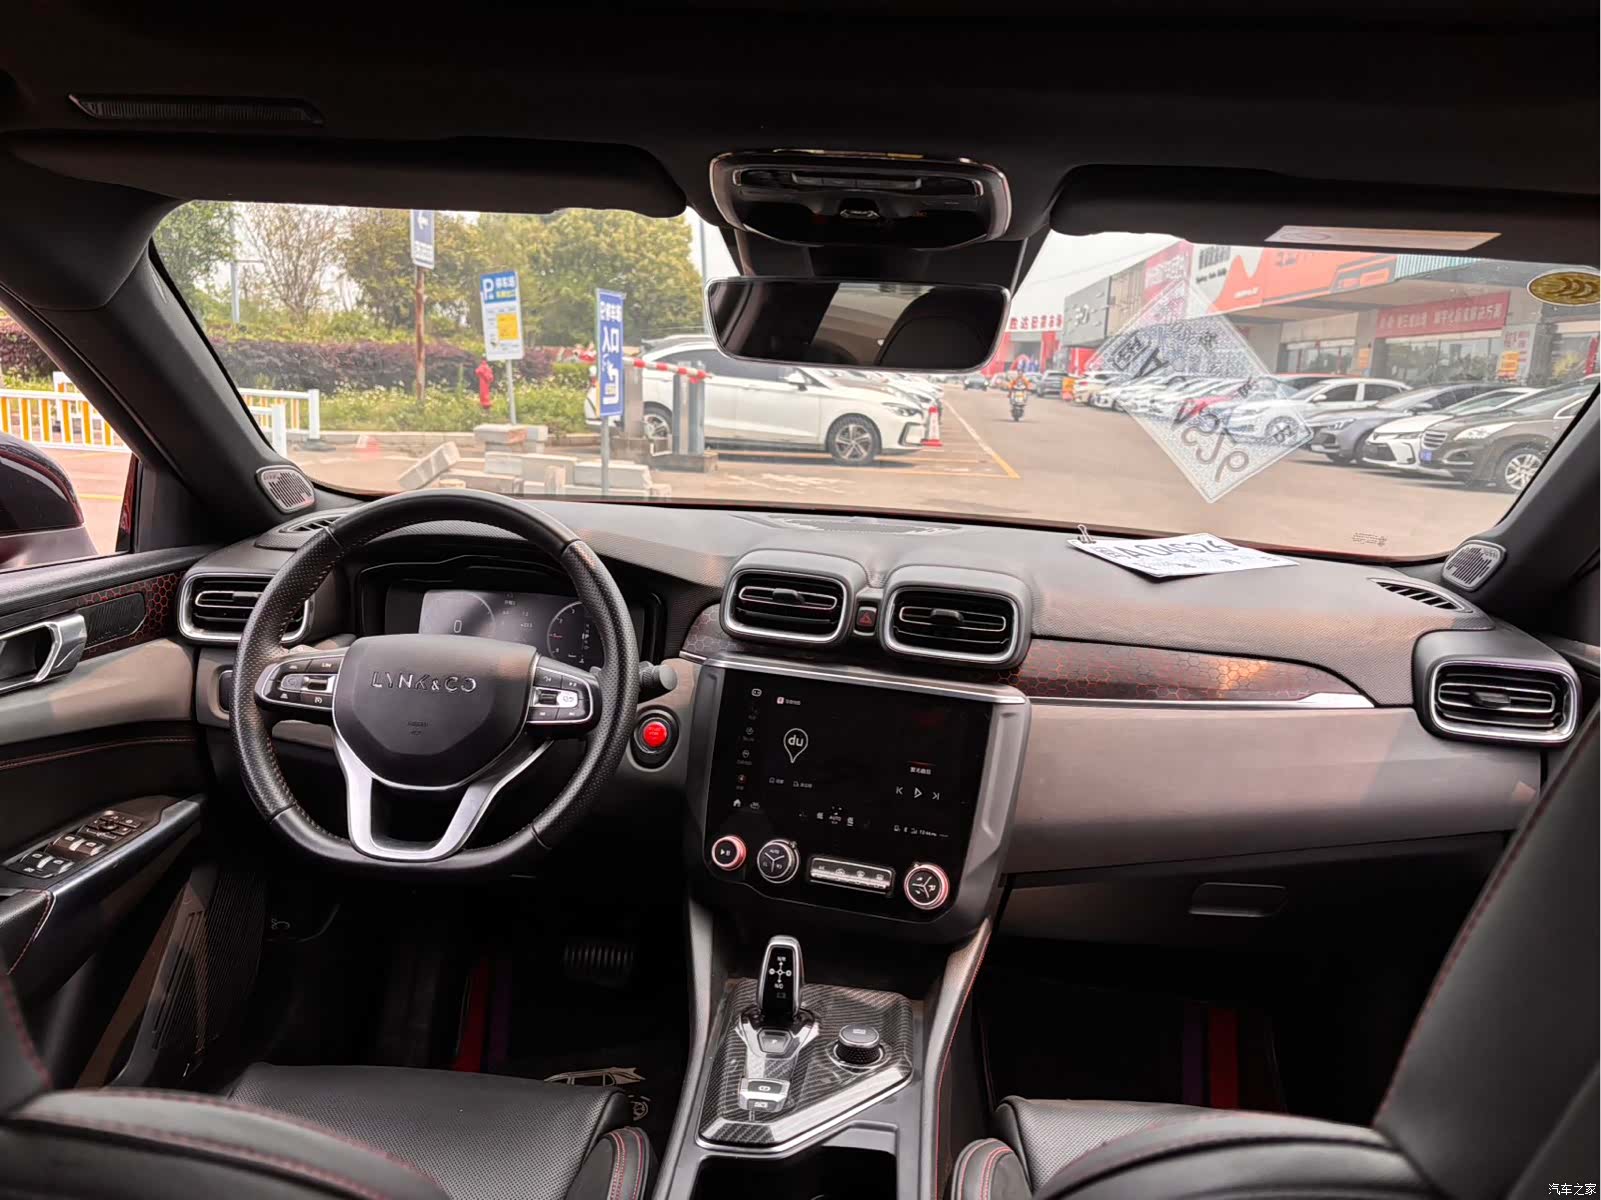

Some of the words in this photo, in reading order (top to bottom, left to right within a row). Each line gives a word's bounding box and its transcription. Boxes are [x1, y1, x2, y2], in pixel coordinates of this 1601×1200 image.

[482, 278, 495, 300] P
[602, 326, 620, 353] 入口
[453, 619, 463, 634] 0
[787, 734, 804, 747] du
